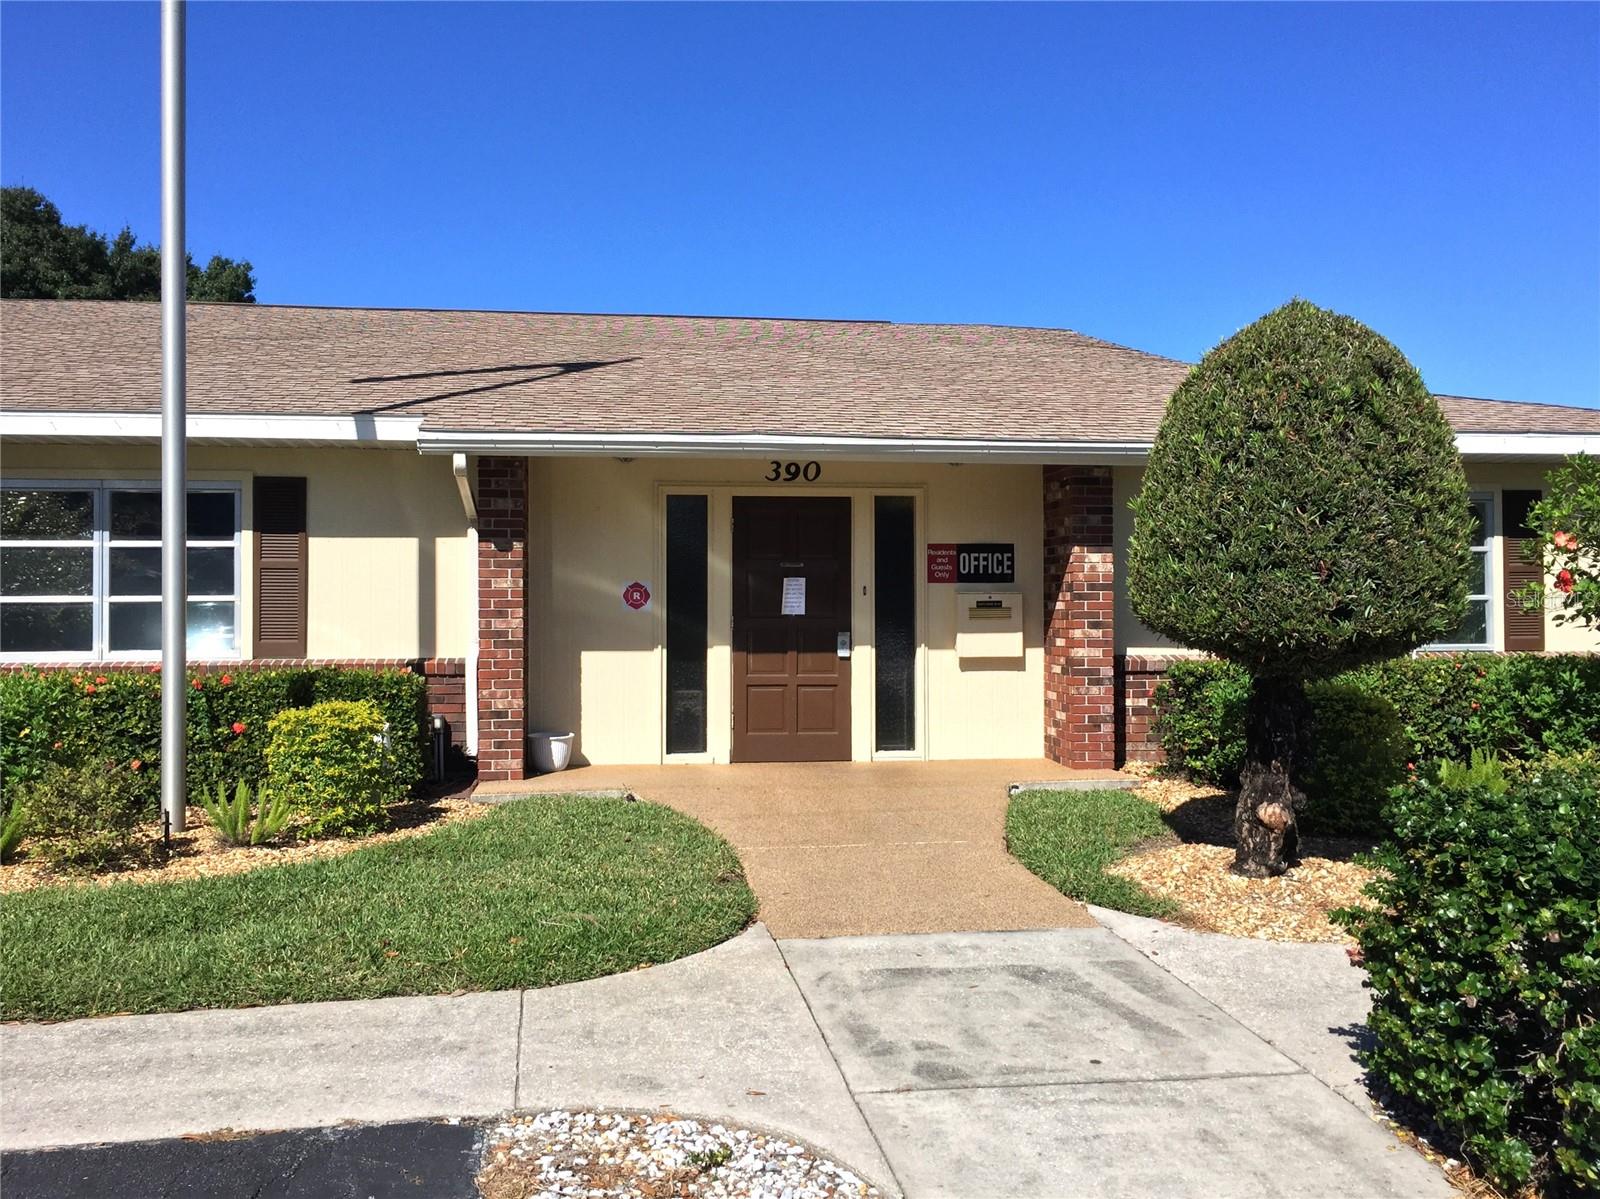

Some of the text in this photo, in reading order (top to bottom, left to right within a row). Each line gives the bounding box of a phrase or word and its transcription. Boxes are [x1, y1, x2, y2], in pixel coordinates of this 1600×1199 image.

[765, 460, 822, 482] 390
[959, 552, 1012, 575] OFFICE
[934, 571, 950, 579] Only
[633, 592, 641, 600] R
